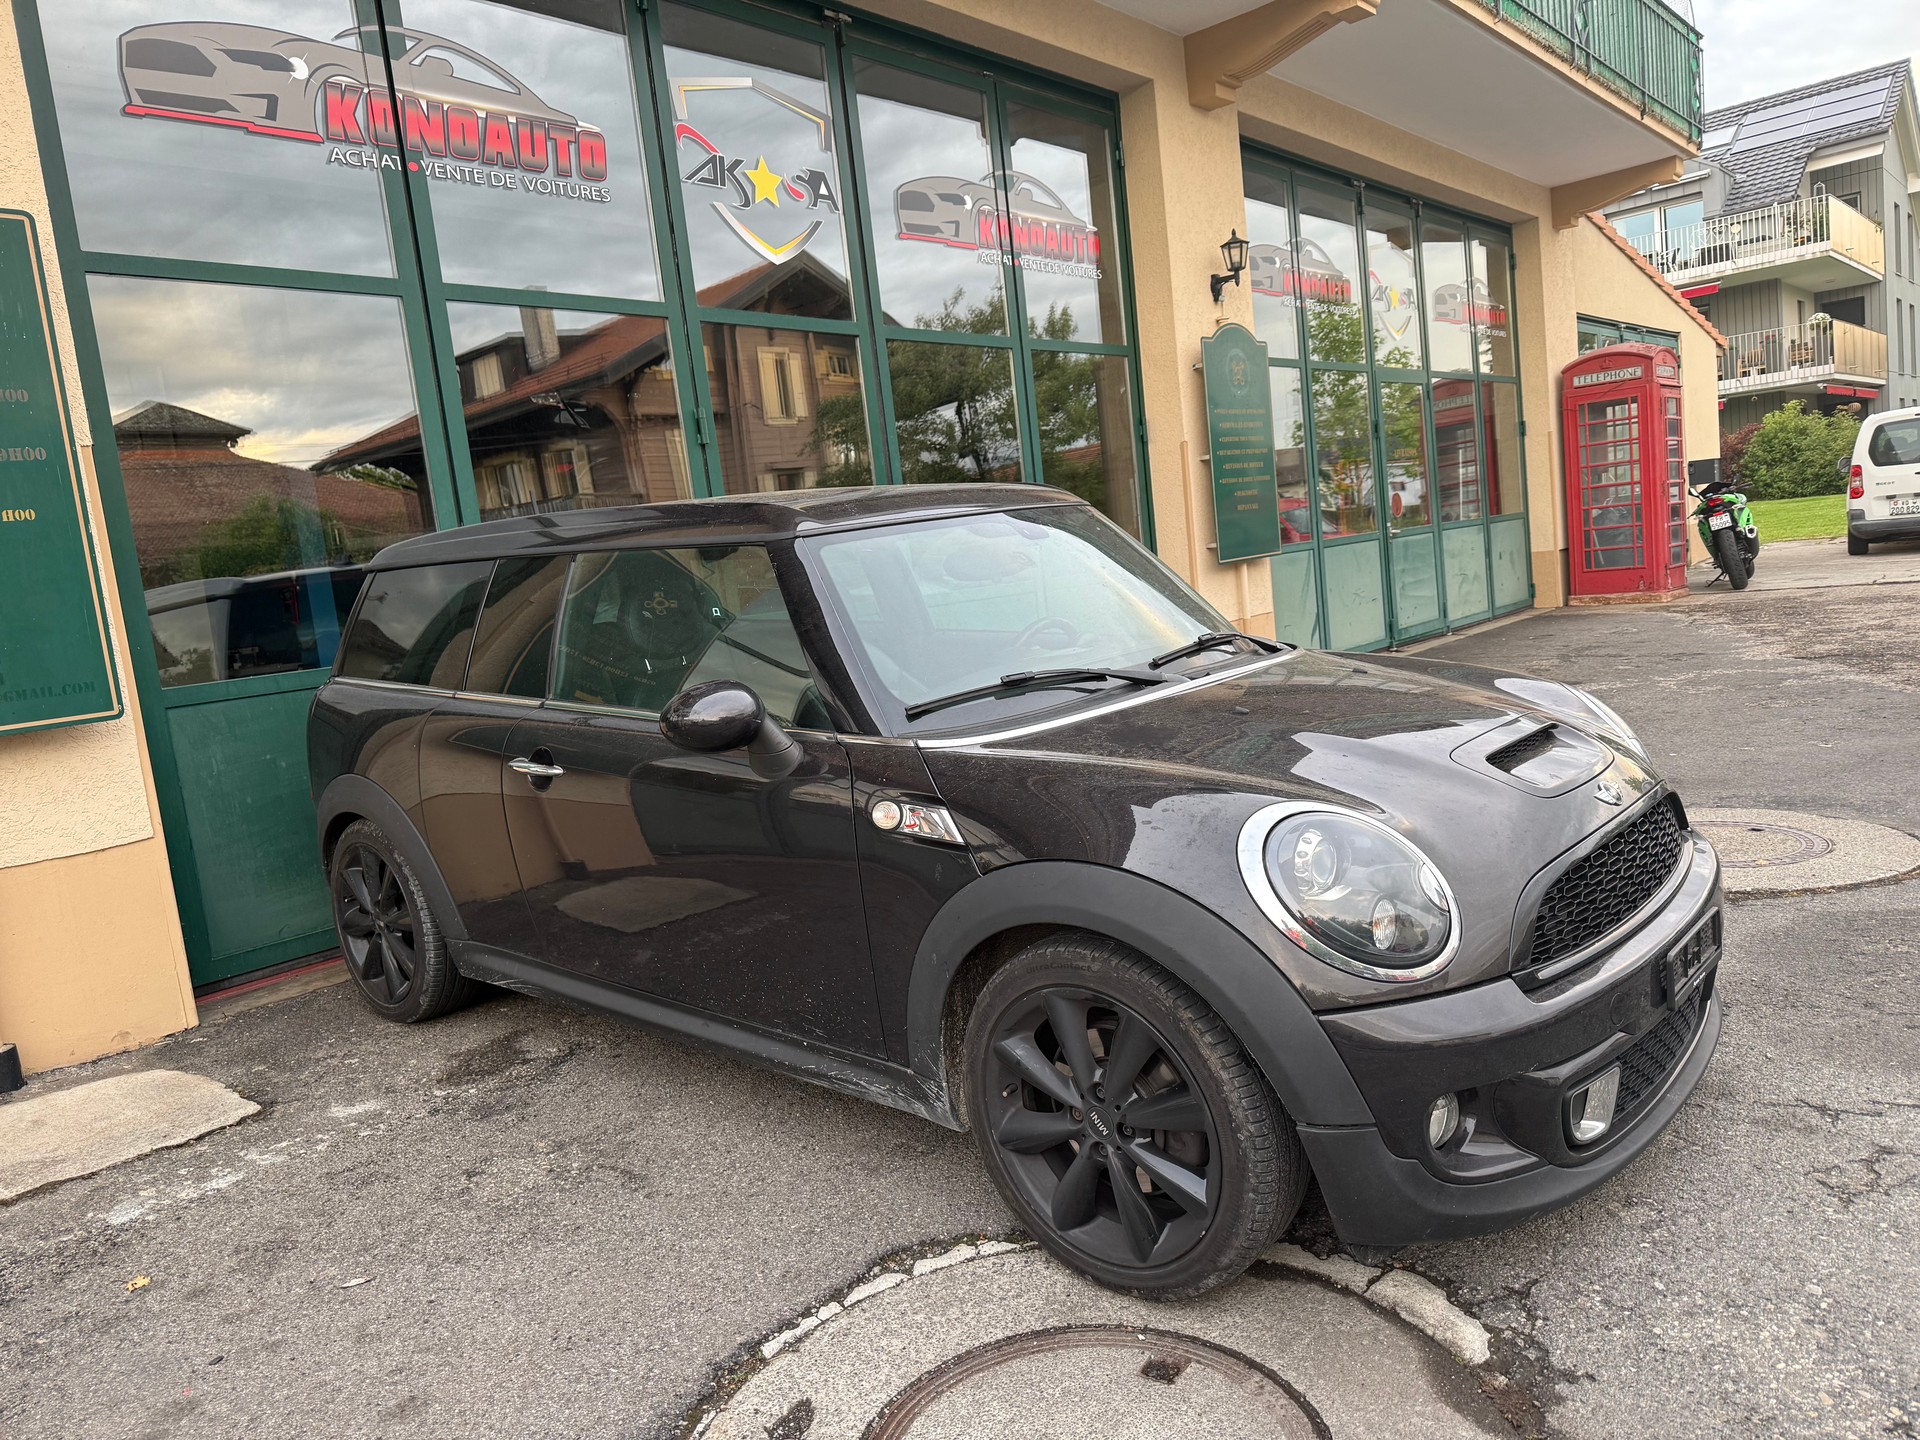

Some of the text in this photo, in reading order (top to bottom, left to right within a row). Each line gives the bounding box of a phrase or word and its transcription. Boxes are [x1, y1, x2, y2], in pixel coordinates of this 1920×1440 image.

[324, 82, 607, 181] KONOAUTO
[330, 147, 611, 203] ACHAT VENTE DE VOITURES
[978, 209, 1100, 265] KONOAUTO
[1048, 263, 1060, 274] DE
[1064, 266, 1103, 280] VOITURES
[1576, 367, 1640, 384] TELEPHONE
[1090, 1111, 1109, 1136] MINI
